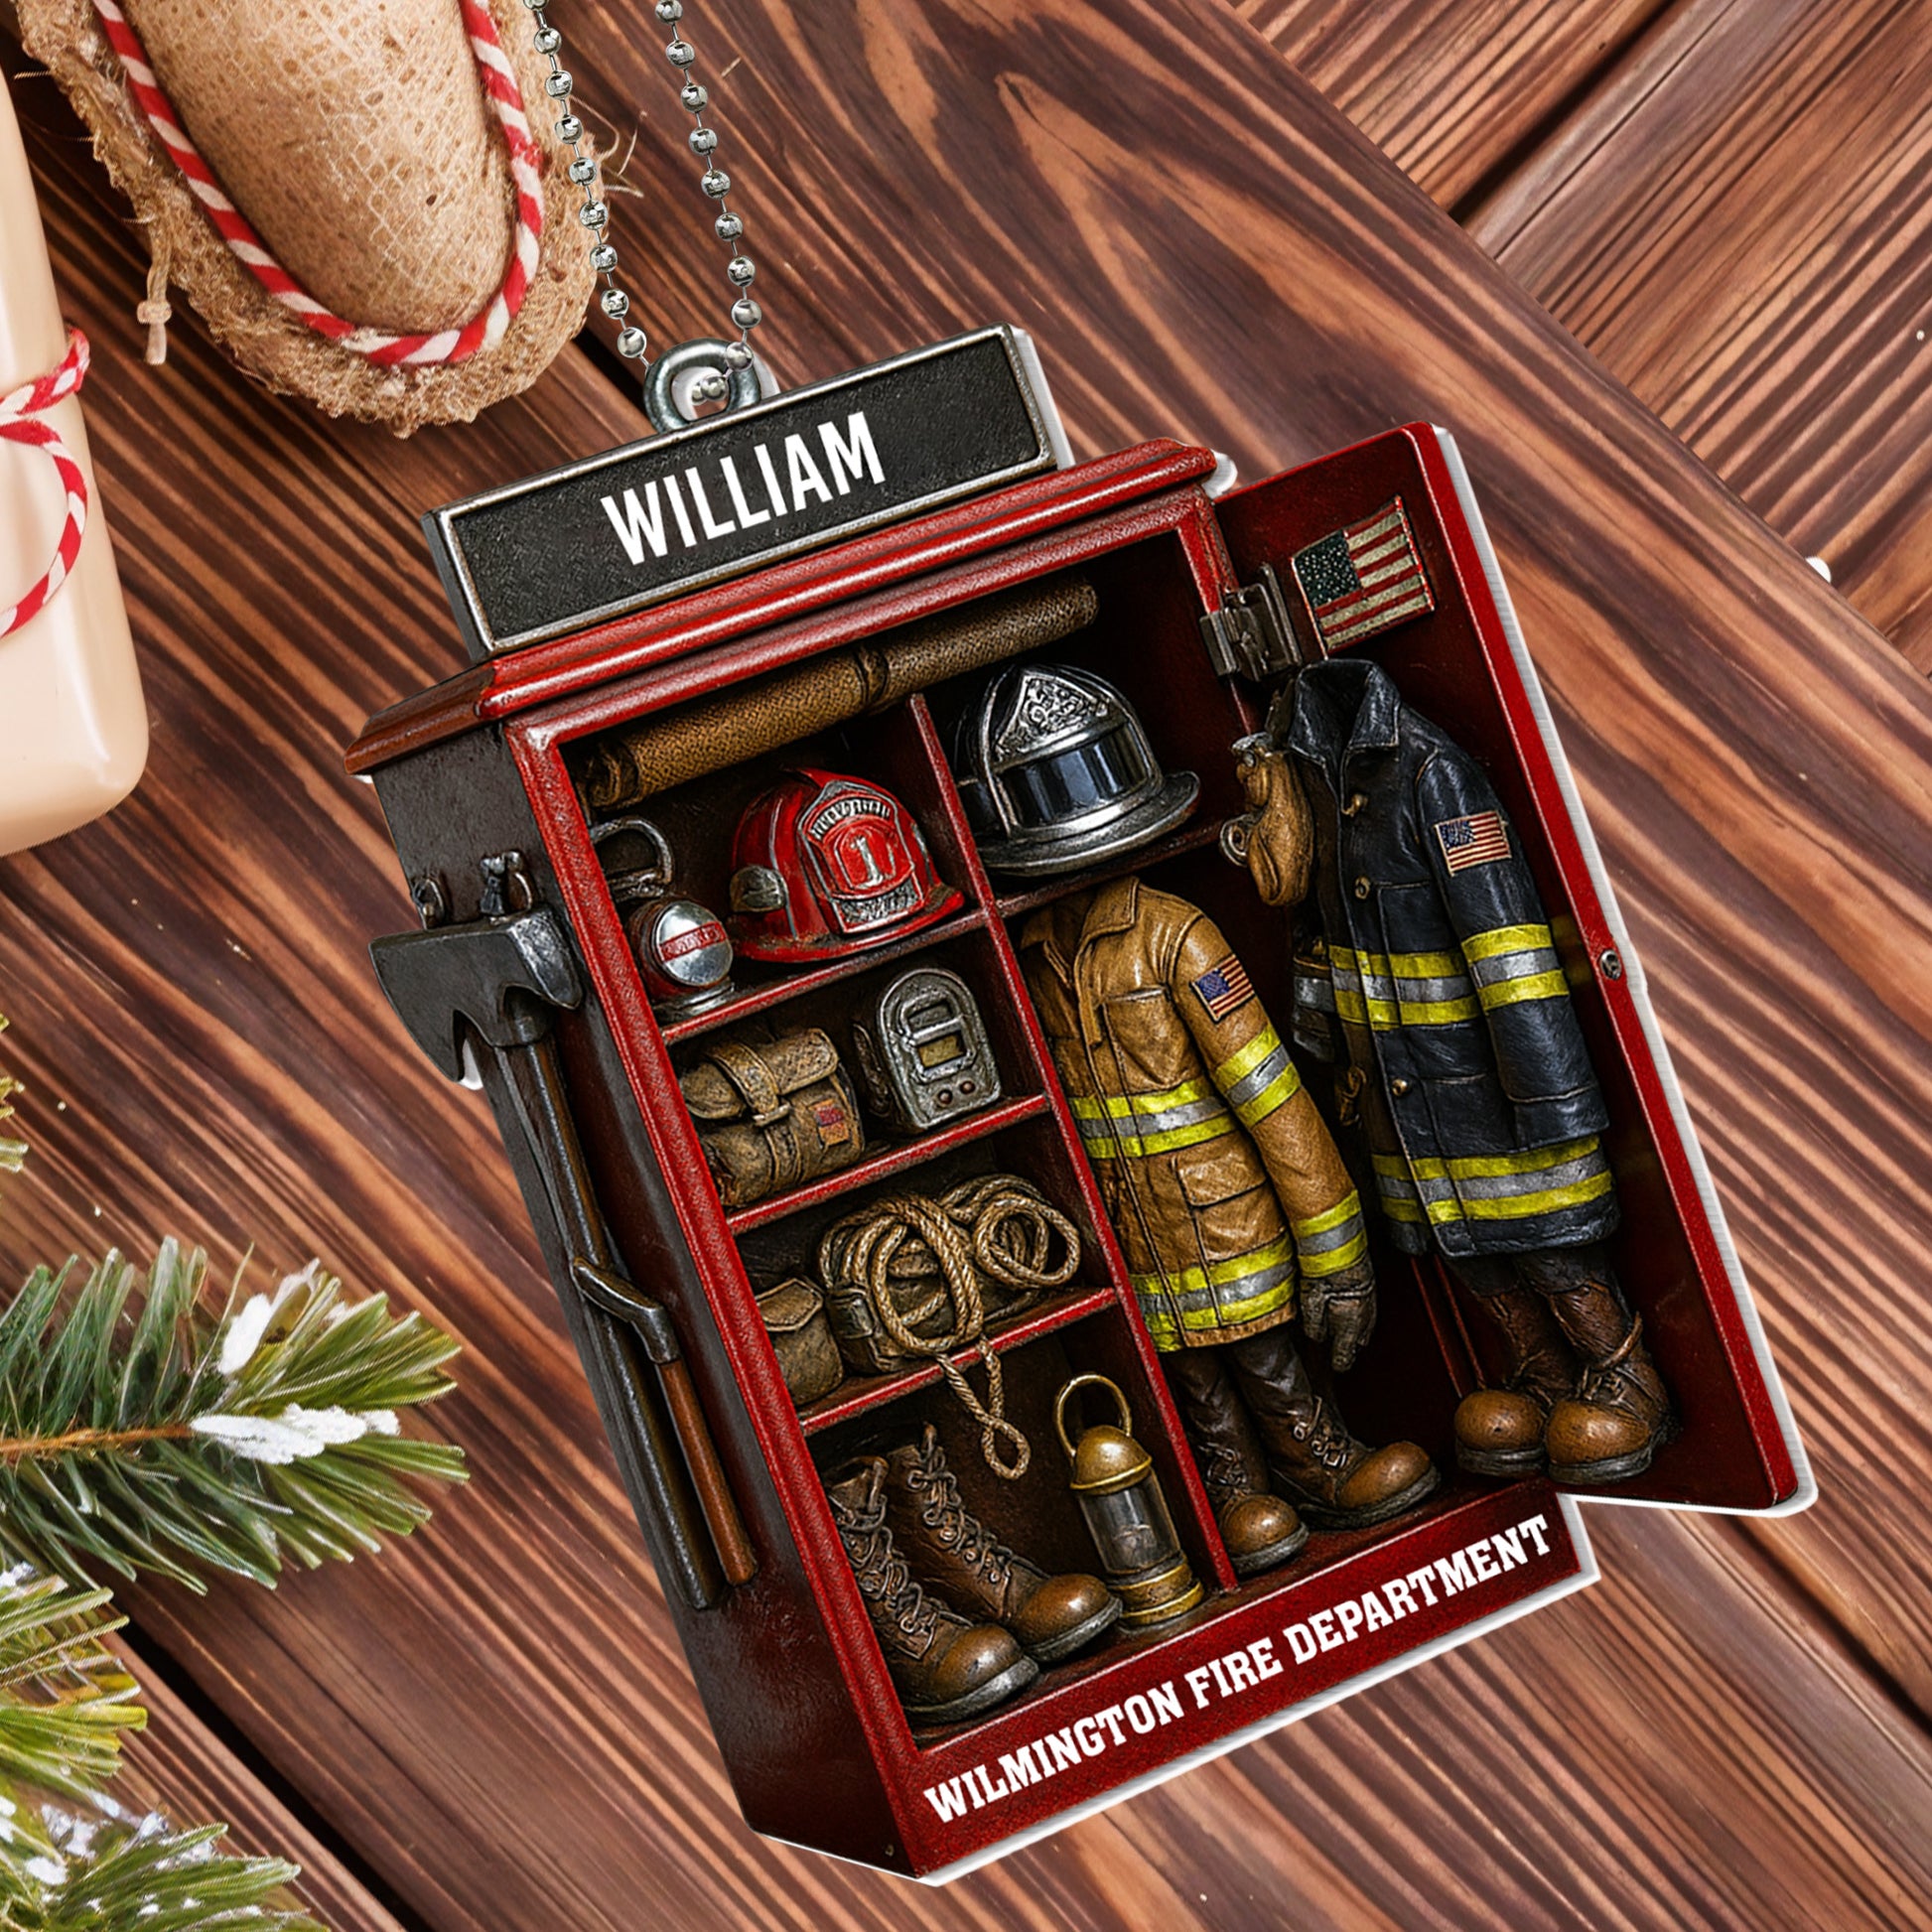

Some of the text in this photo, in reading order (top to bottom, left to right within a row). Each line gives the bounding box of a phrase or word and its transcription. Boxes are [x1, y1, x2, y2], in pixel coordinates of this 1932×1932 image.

[600, 411, 886, 566] WILLIAM
[850, 835, 884, 890] 1
[922, 1514, 1551, 1823] WILMINGTON FIRE DEPARTMENT
